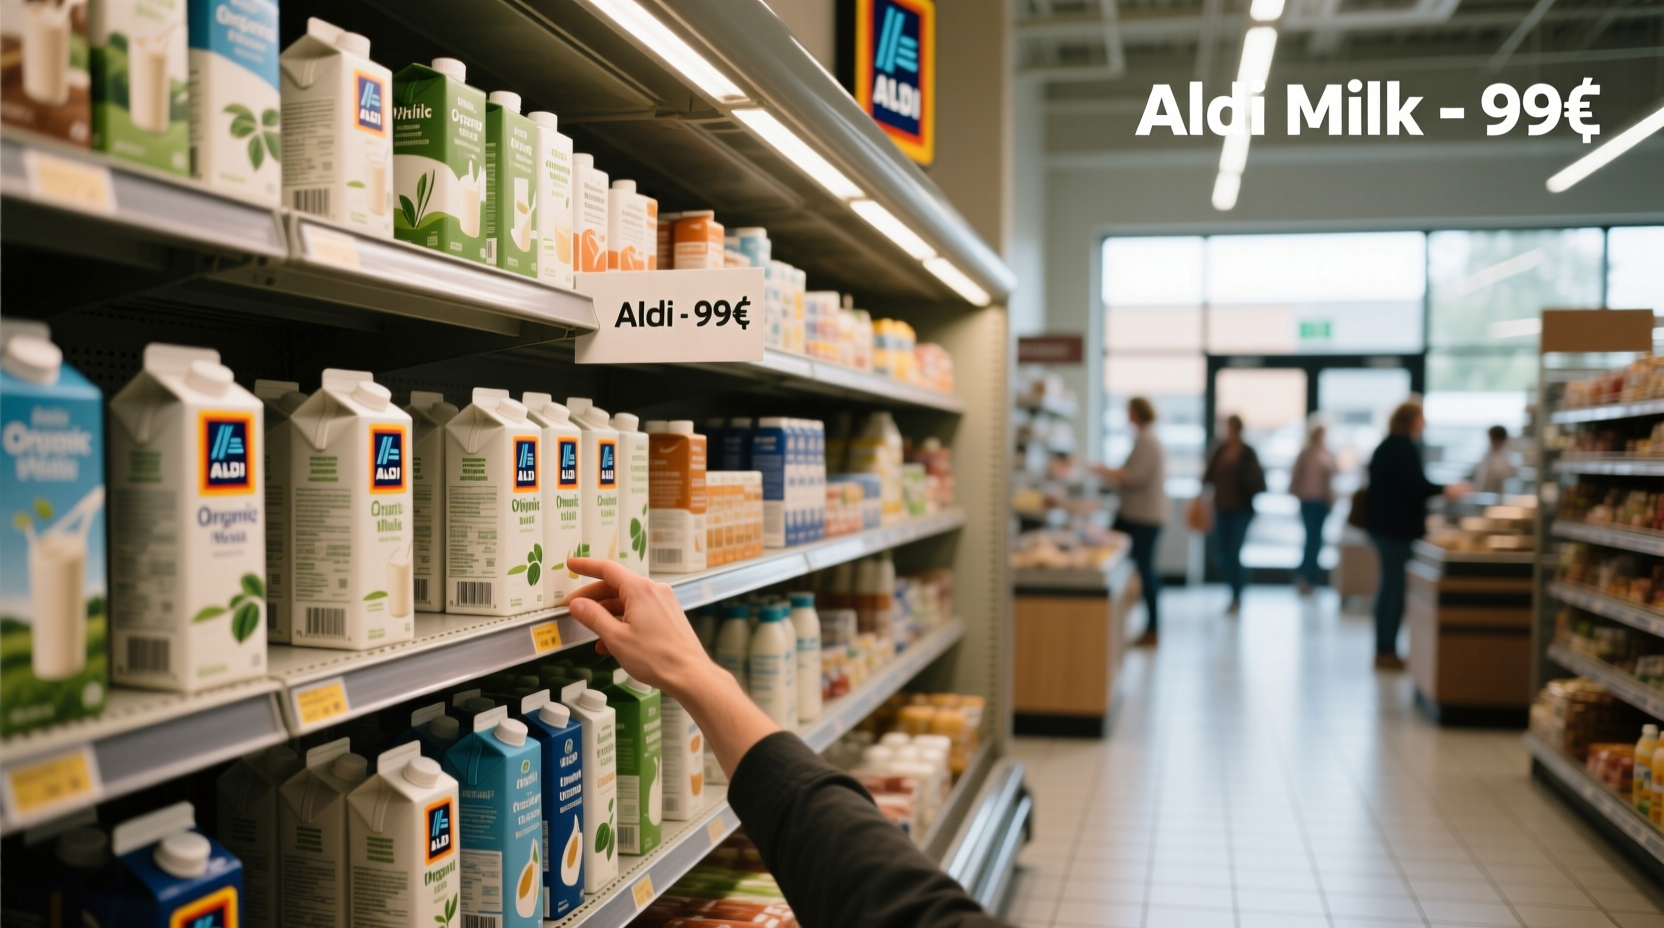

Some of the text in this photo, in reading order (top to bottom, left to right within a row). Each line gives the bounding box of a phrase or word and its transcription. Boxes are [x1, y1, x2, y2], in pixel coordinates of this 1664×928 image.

[873, 74, 921, 121] ALDI
[614, 300, 673, 328] Aldi
[694, 296, 750, 331] 99€
[210, 461, 246, 479] ALDI
[375, 466, 401, 480] ALDI
